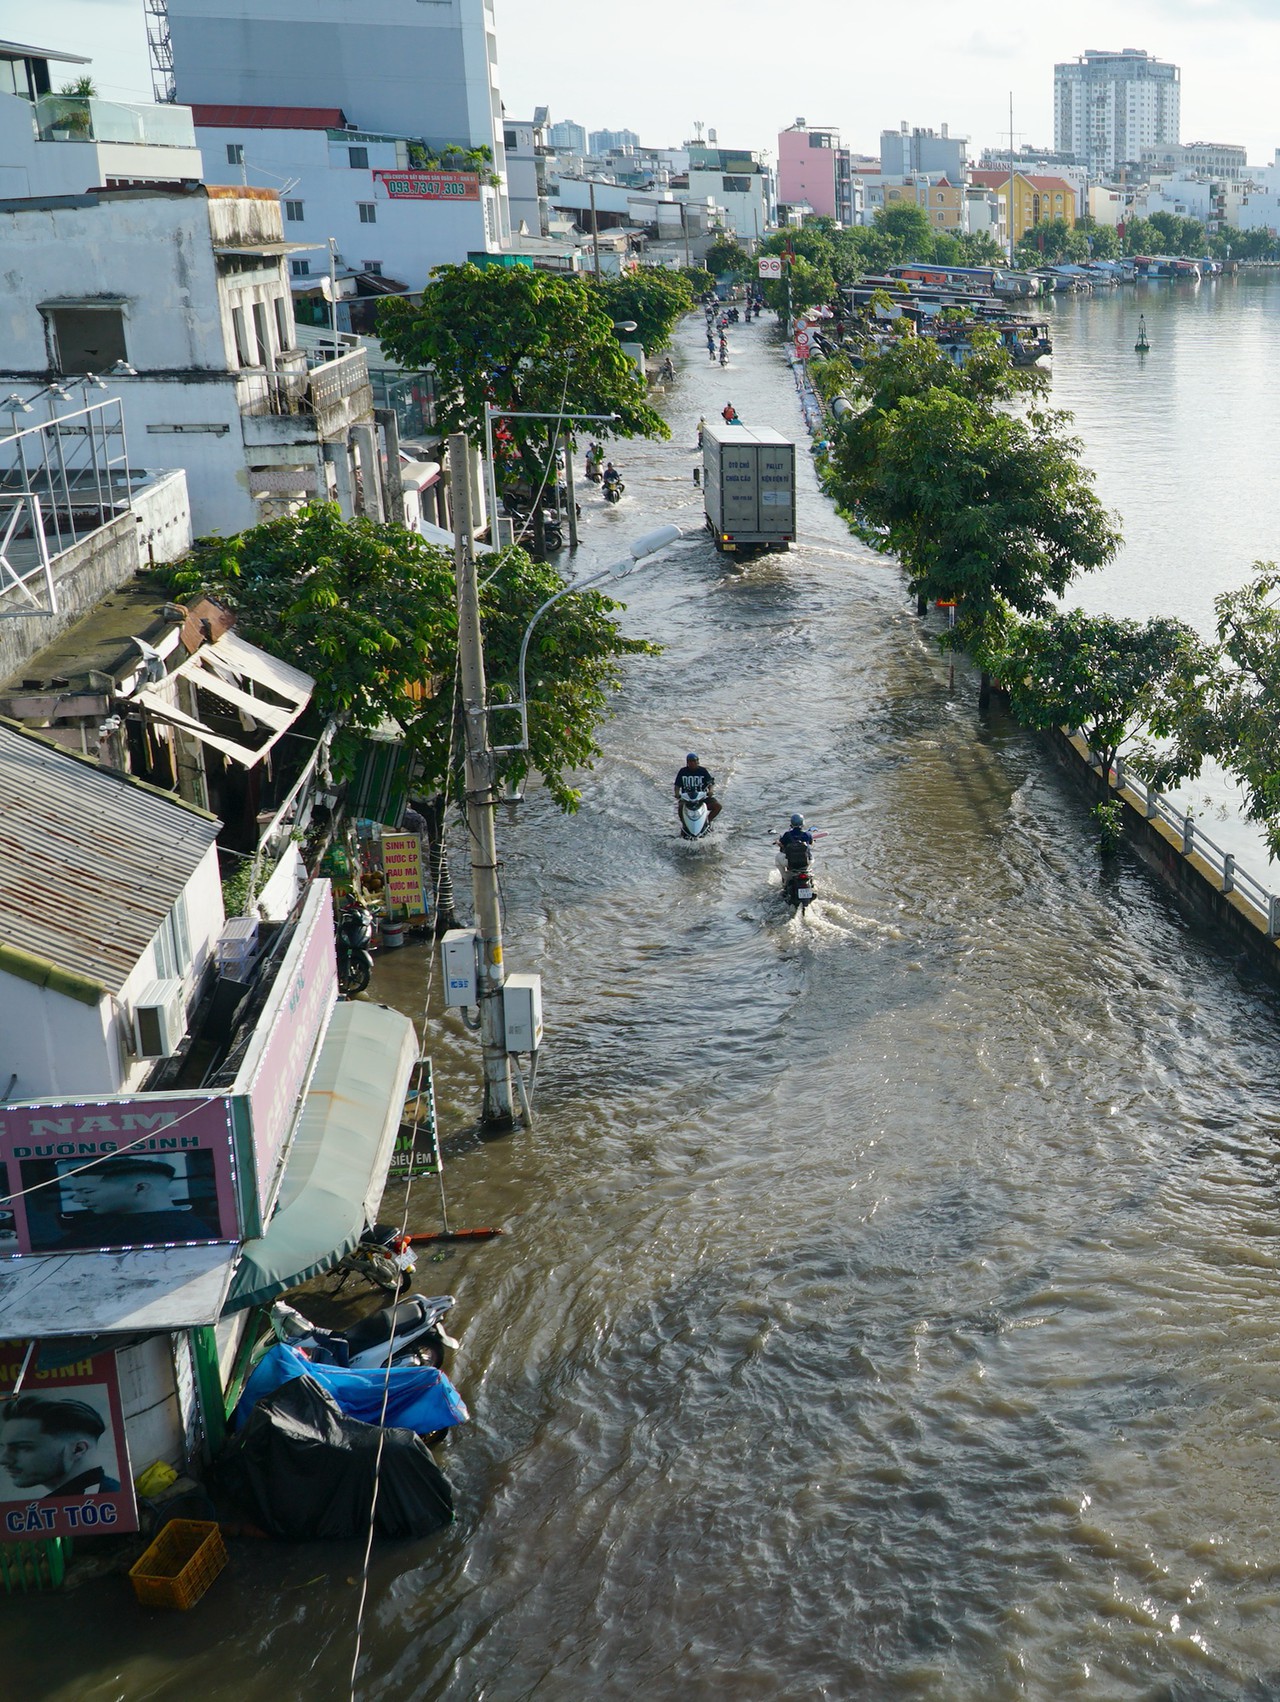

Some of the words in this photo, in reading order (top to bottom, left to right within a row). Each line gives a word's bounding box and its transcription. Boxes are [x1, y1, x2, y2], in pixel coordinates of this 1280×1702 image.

[388, 181, 465, 195] 093.7347.303
[385, 841, 405, 850] SINH
[385, 854, 407, 864] NƯỚC
[388, 869, 403, 877] RAU
[28, 1111, 180, 1136] NAM
[13, 1139, 118, 1158] DƯỠNG
[128, 1136, 199, 1150] SINH
[6, 1502, 57, 1532] CẮT
[64, 1499, 118, 1527] TÓC
